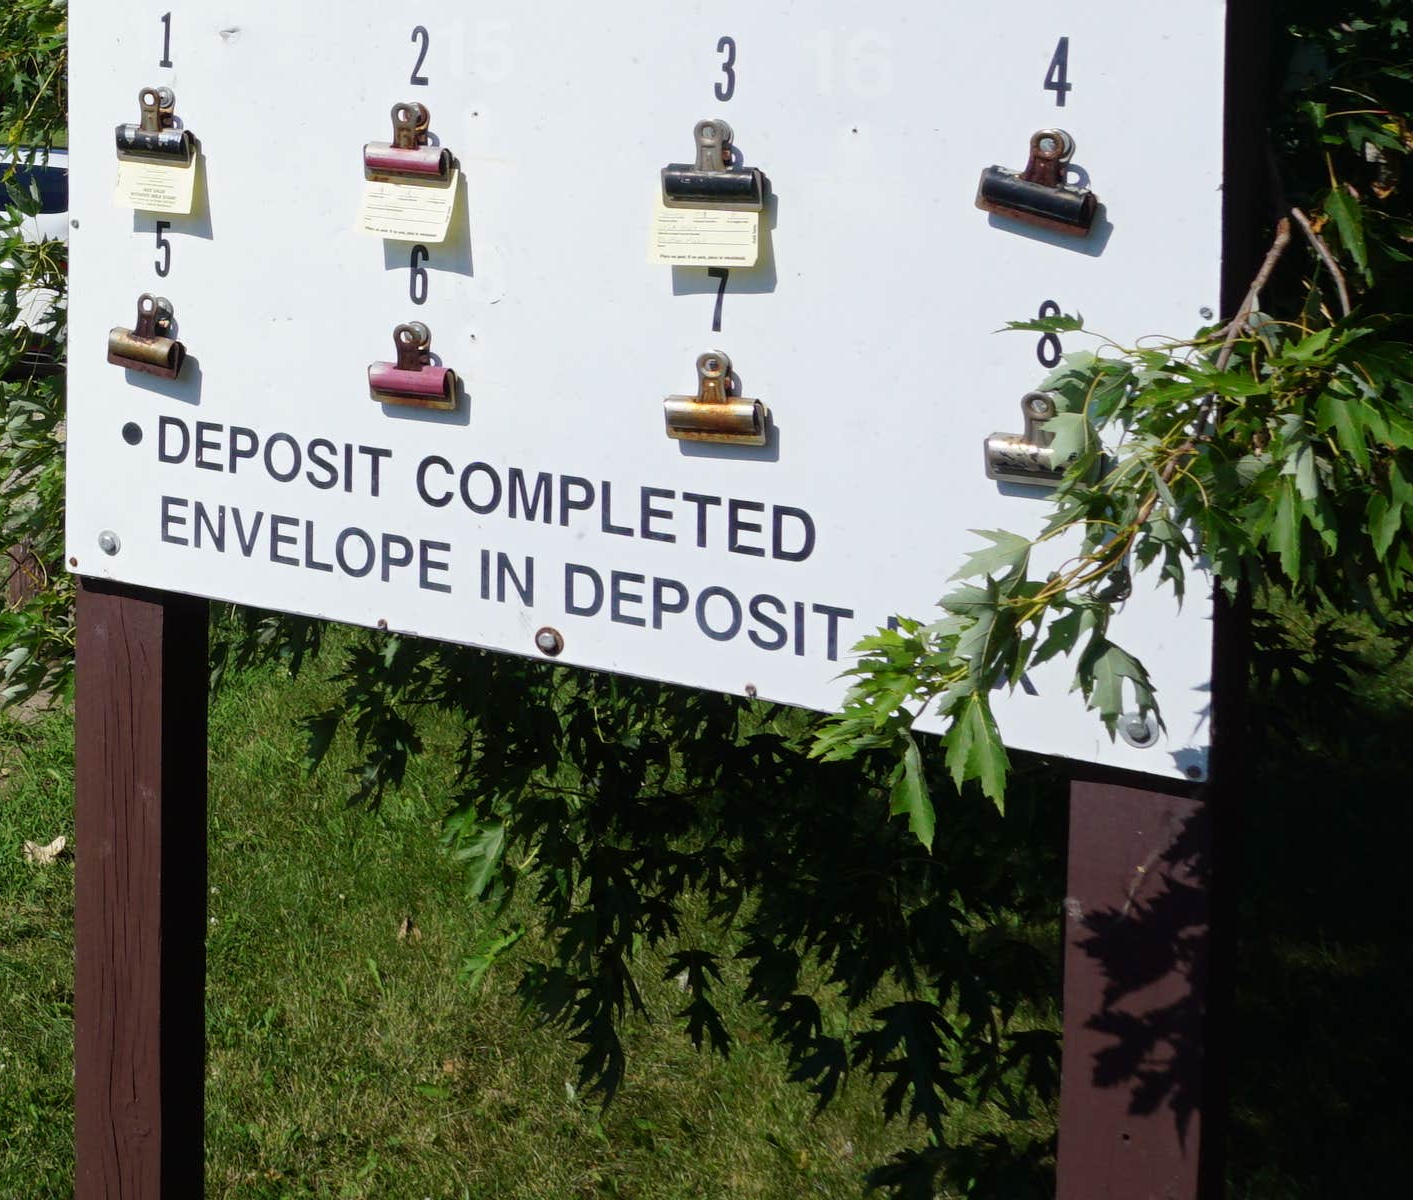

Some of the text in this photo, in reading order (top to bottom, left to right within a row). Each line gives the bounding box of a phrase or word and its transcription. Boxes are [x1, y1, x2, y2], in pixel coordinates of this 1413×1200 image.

[159, 12, 173, 69] 1
[410, 25, 430, 86] 2
[714, 36, 736, 102] 3
[1043, 36, 1072, 107] 4
[155, 221, 170, 278] 5
[411, 244, 429, 305] 6
[708, 268, 729, 333] 7
[1037, 300, 1062, 369] 8
[158, 415, 816, 567] DEPOSIT COMPLETED
[160, 494, 452, 595] ENVELOPE
[480, 549, 534, 608] IN
[564, 562, 854, 662] DEPOSIT
